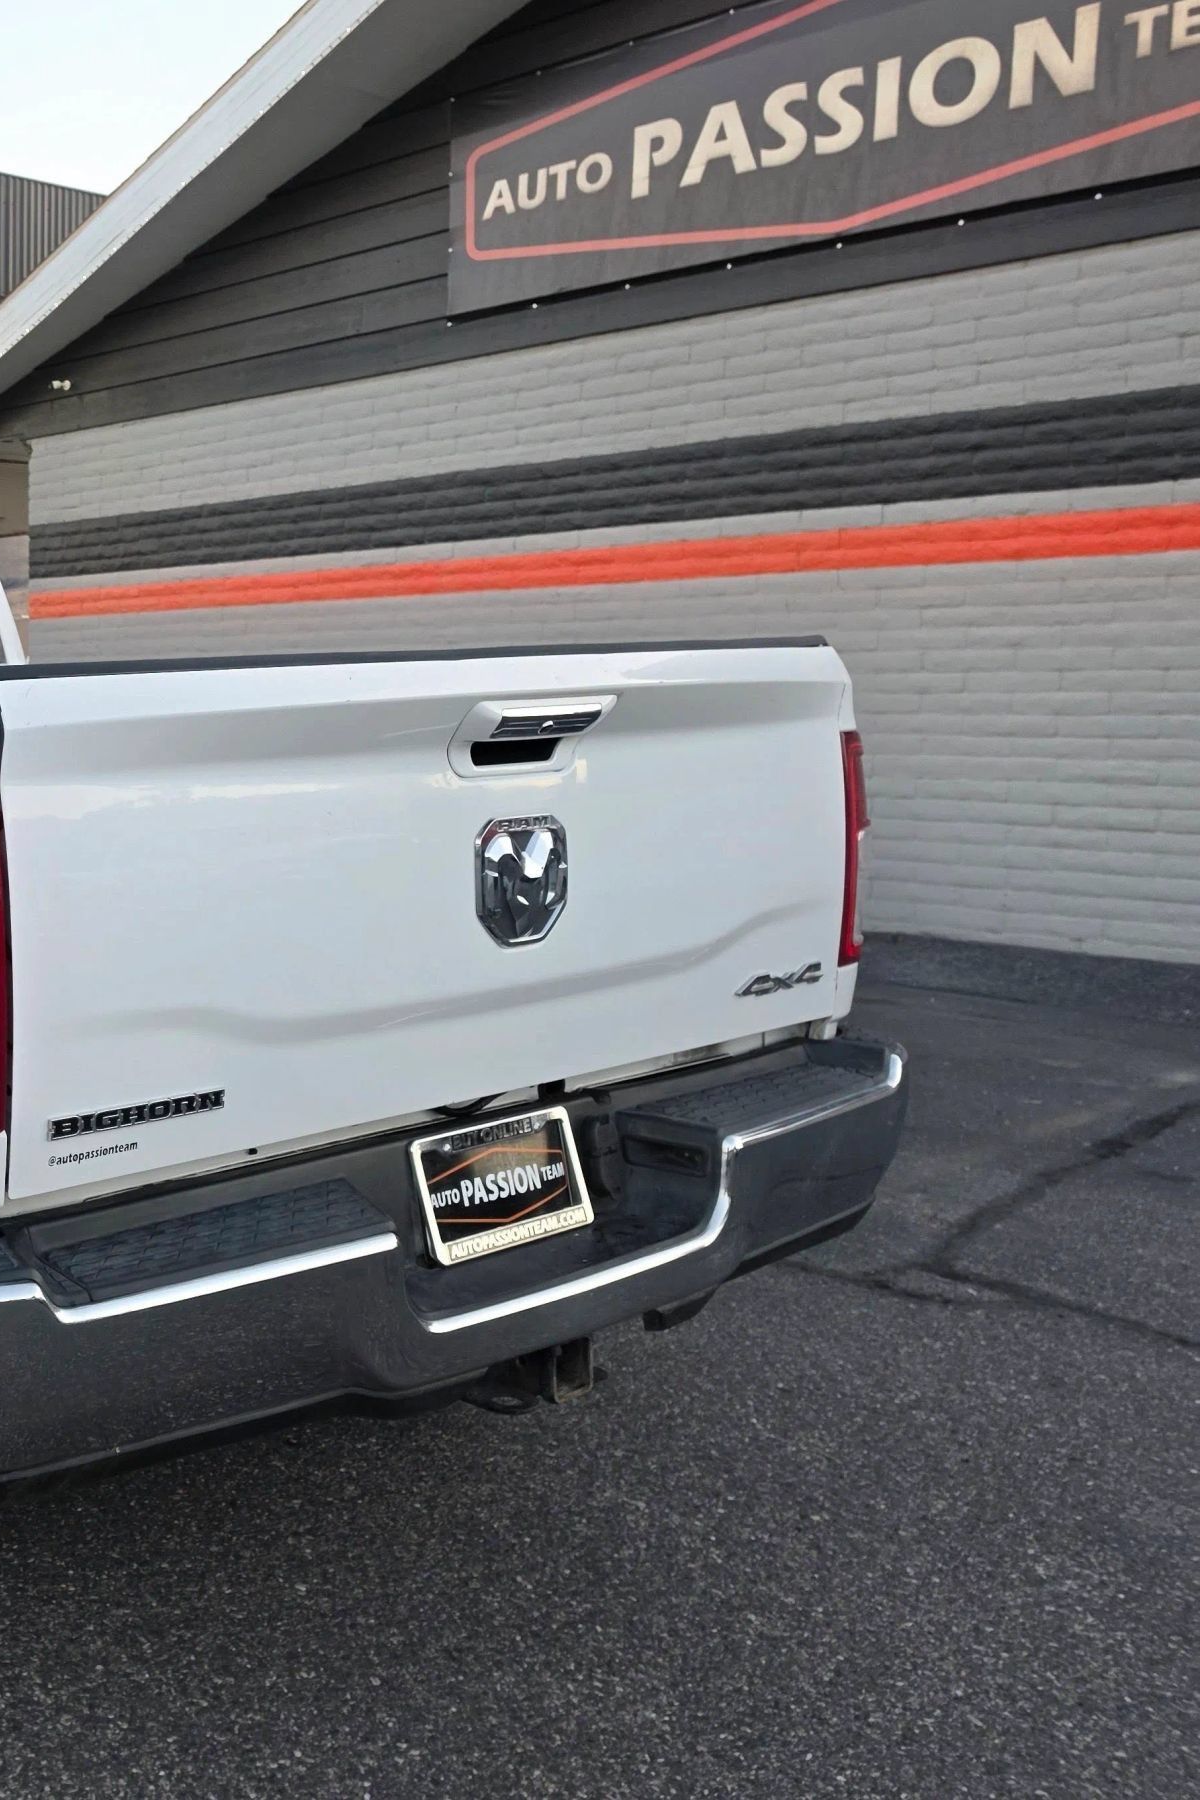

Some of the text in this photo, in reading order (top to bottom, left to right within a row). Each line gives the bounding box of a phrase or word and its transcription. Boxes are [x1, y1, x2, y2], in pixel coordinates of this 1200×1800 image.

[482, 152, 614, 221] AUTO
[629, 2, 1101, 200] PASSION
[497, 815, 552, 832] RAM
[47, 1089, 225, 1141] BIGHORN
[452, 1118, 533, 1150] BUY ONLINE
[47, 1141, 138, 1167] @autopassionteam
[431, 1162, 566, 1209] AUTO PASSION TEAM
[450, 1208, 587, 1260] AUTOPASSIONTEAM.COM
